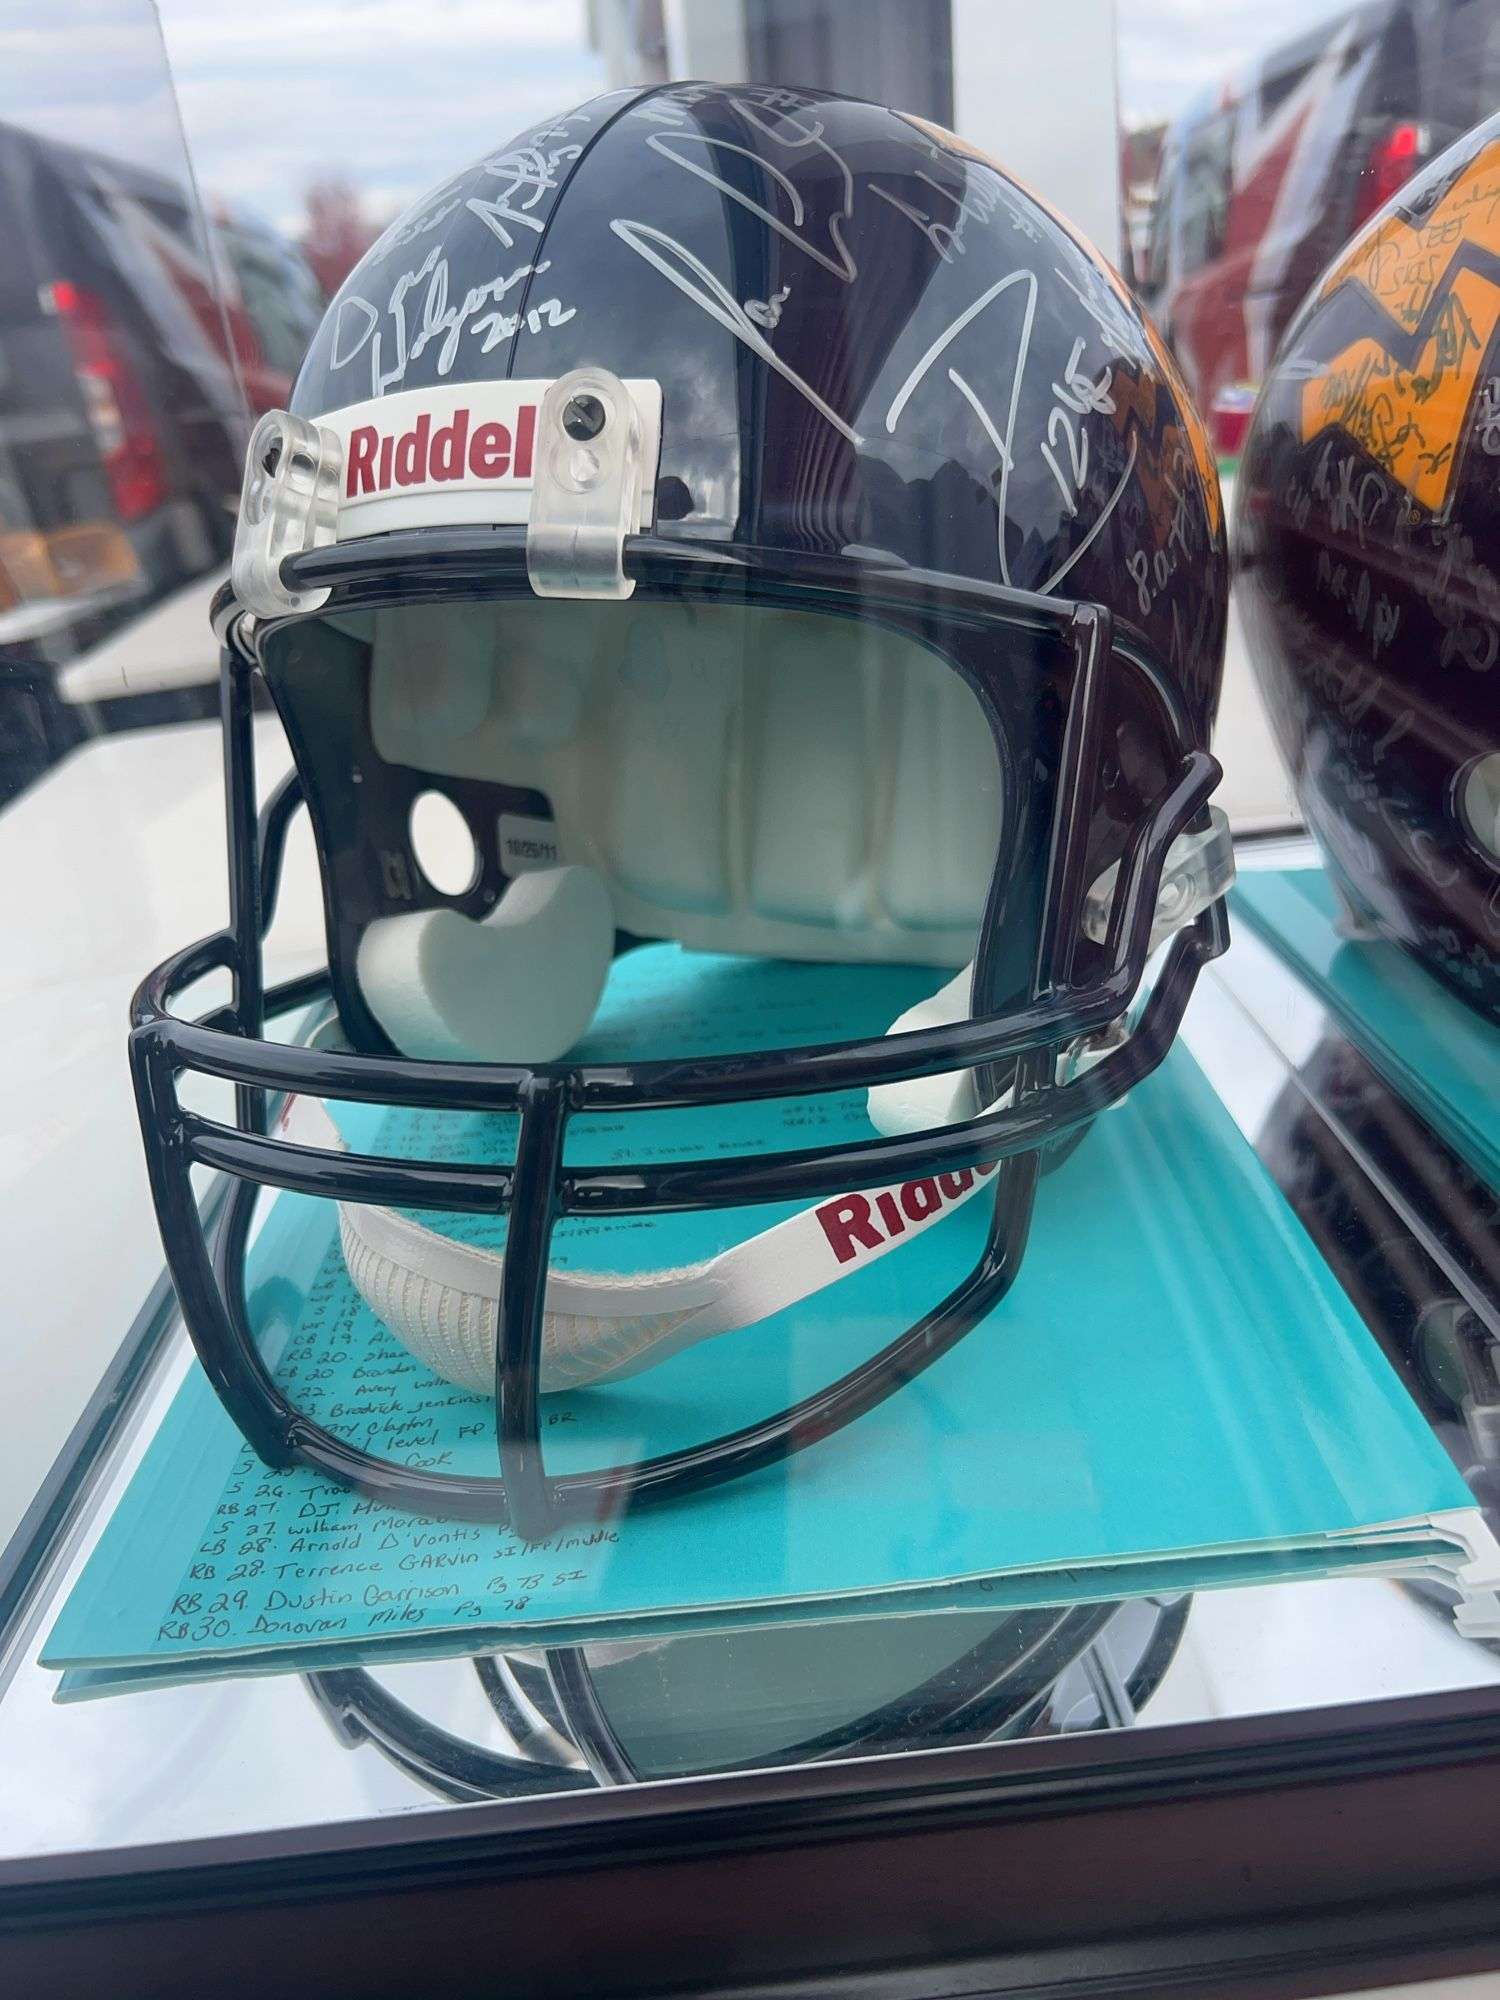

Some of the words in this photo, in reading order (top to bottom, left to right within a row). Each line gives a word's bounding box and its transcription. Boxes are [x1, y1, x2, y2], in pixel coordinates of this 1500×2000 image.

[346, 404, 538, 499] Riddel
[216, 1502, 240, 1516] RB
[289, 1533, 362, 1553] Arnold
[189, 1562, 217, 1580] RB
[273, 1561, 384, 1580] Terrence
[171, 1592, 203, 1616] RB
[263, 1586, 353, 1611] Dustin
[362, 1580, 461, 1607] Garrison
[157, 1620, 190, 1642] RB
[246, 1613, 348, 1635] Donovan
